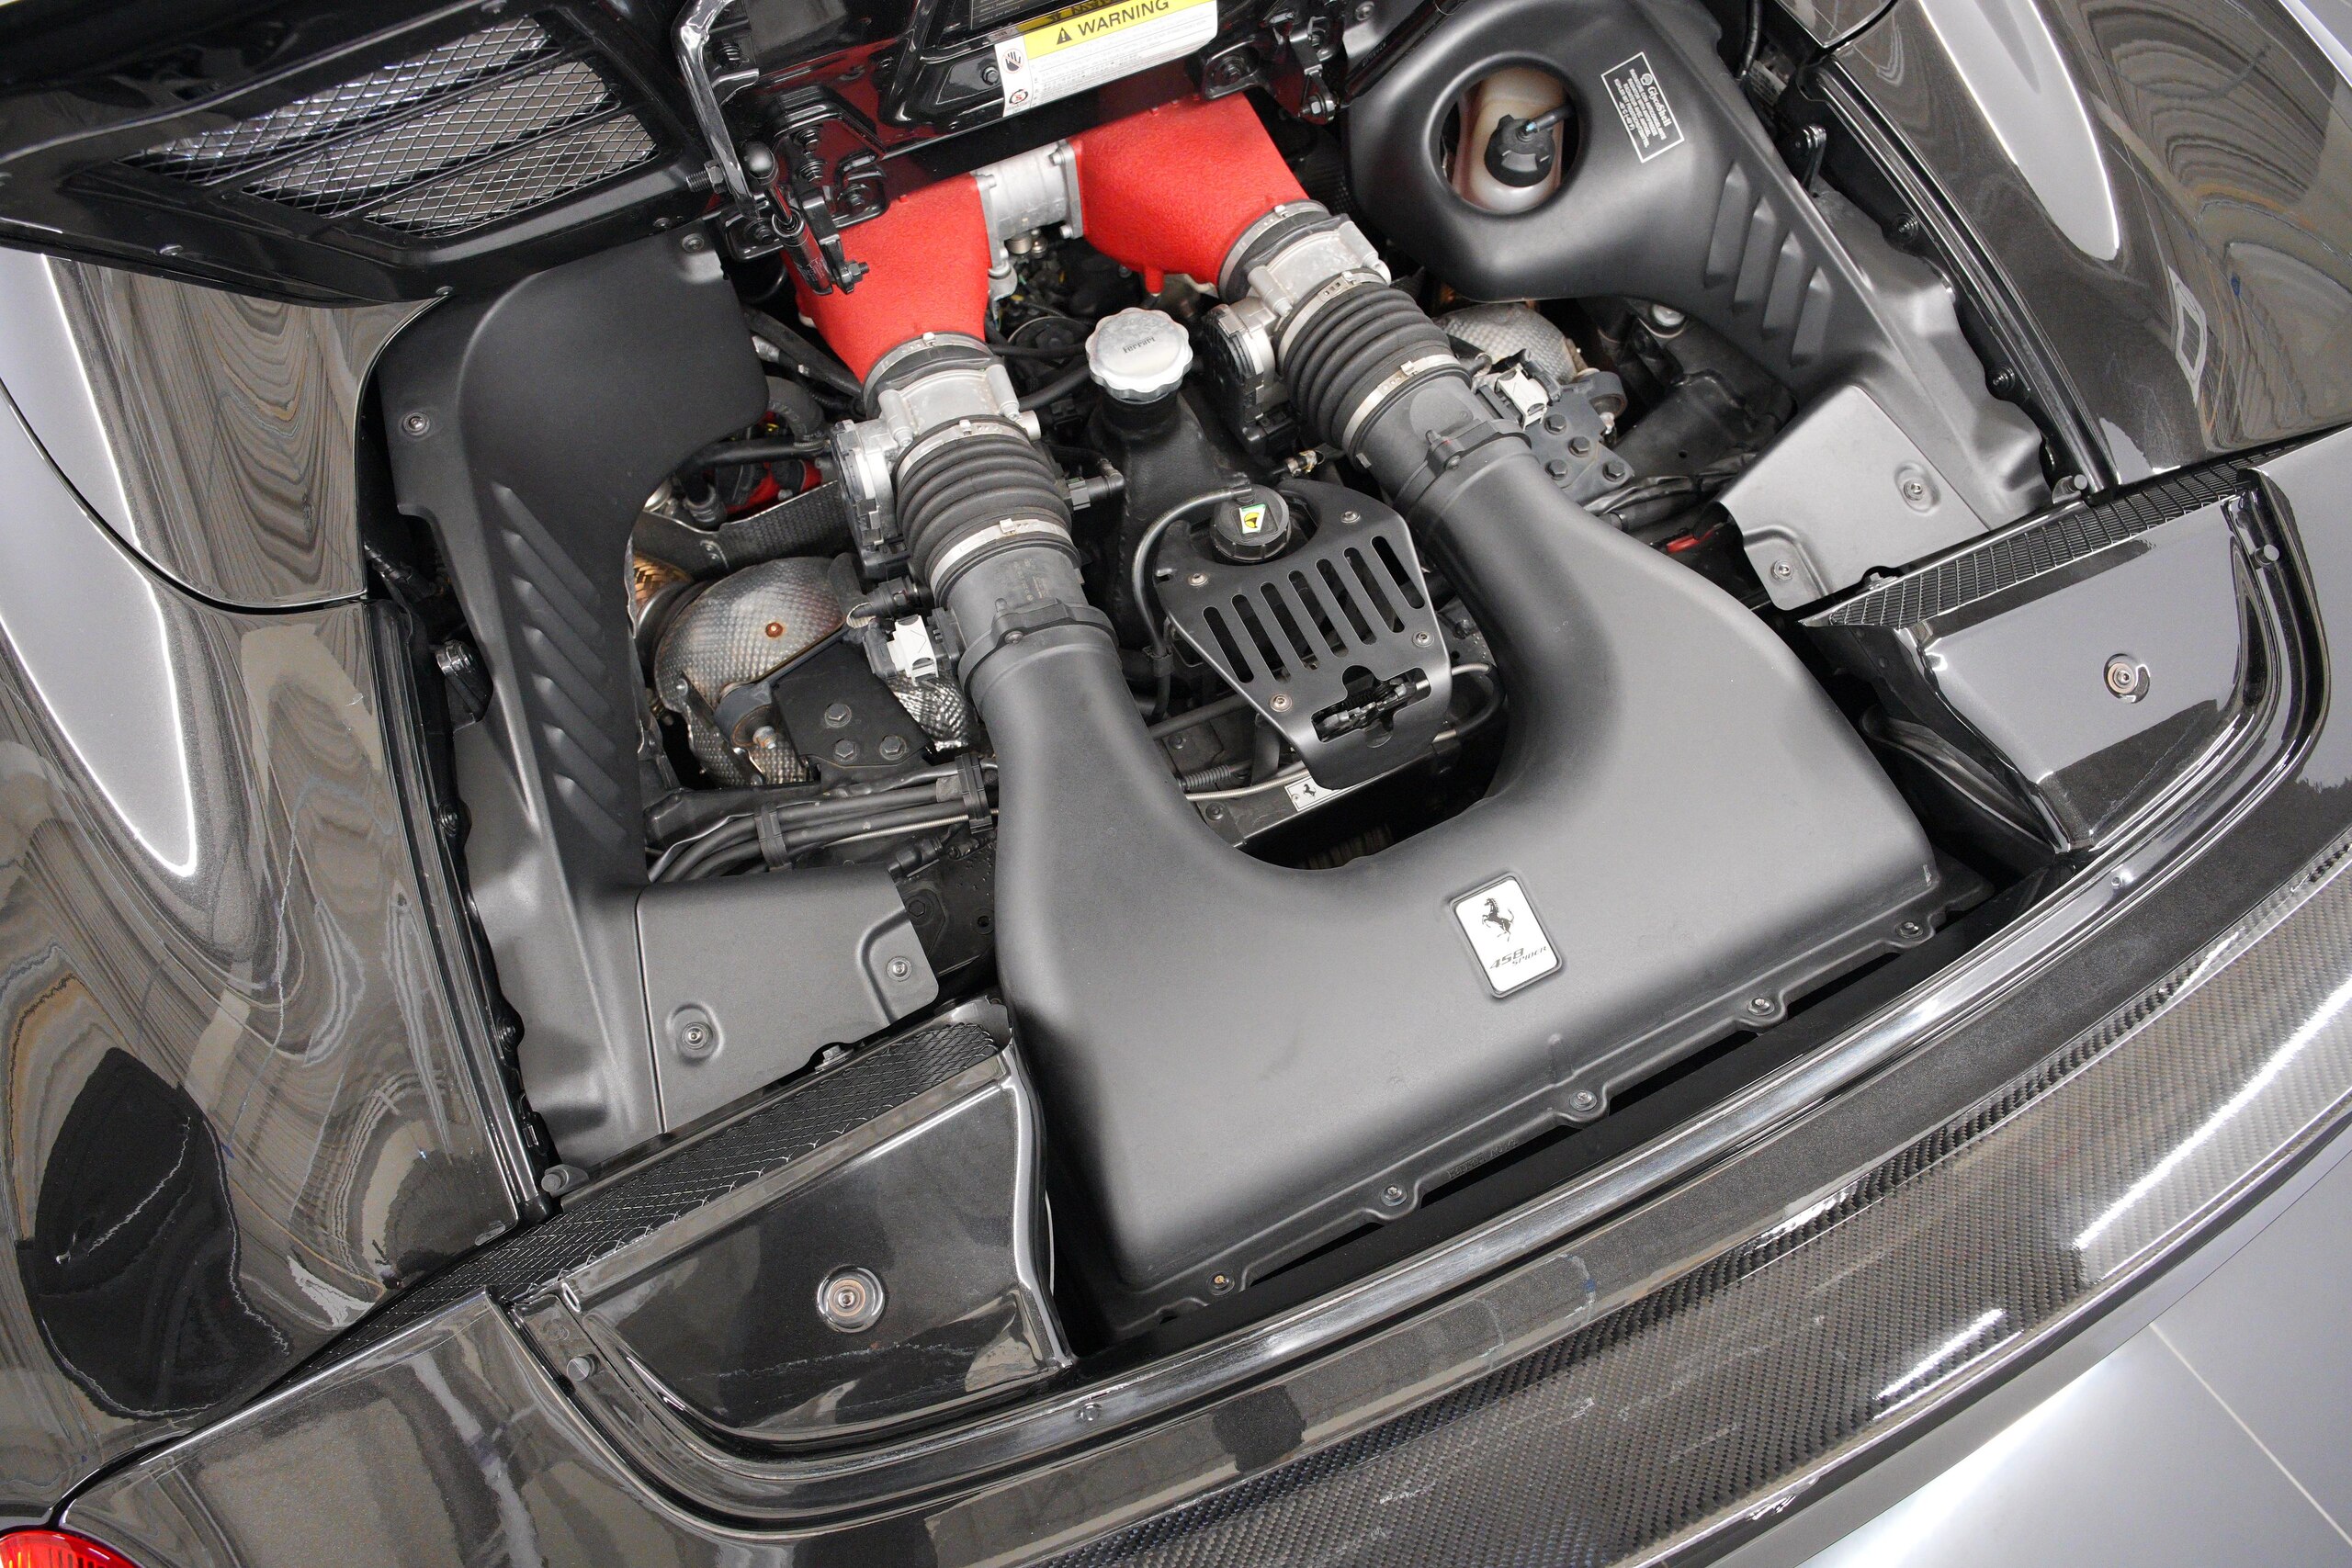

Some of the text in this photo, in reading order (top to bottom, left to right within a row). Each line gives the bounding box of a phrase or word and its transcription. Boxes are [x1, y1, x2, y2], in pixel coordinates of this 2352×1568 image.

[1078, 0, 1169, 36] WARNING
[1647, 86, 1672, 127] GlycoShell
[1122, 336, 1156, 353] Ferrari
[1489, 947, 1525, 969] 458
